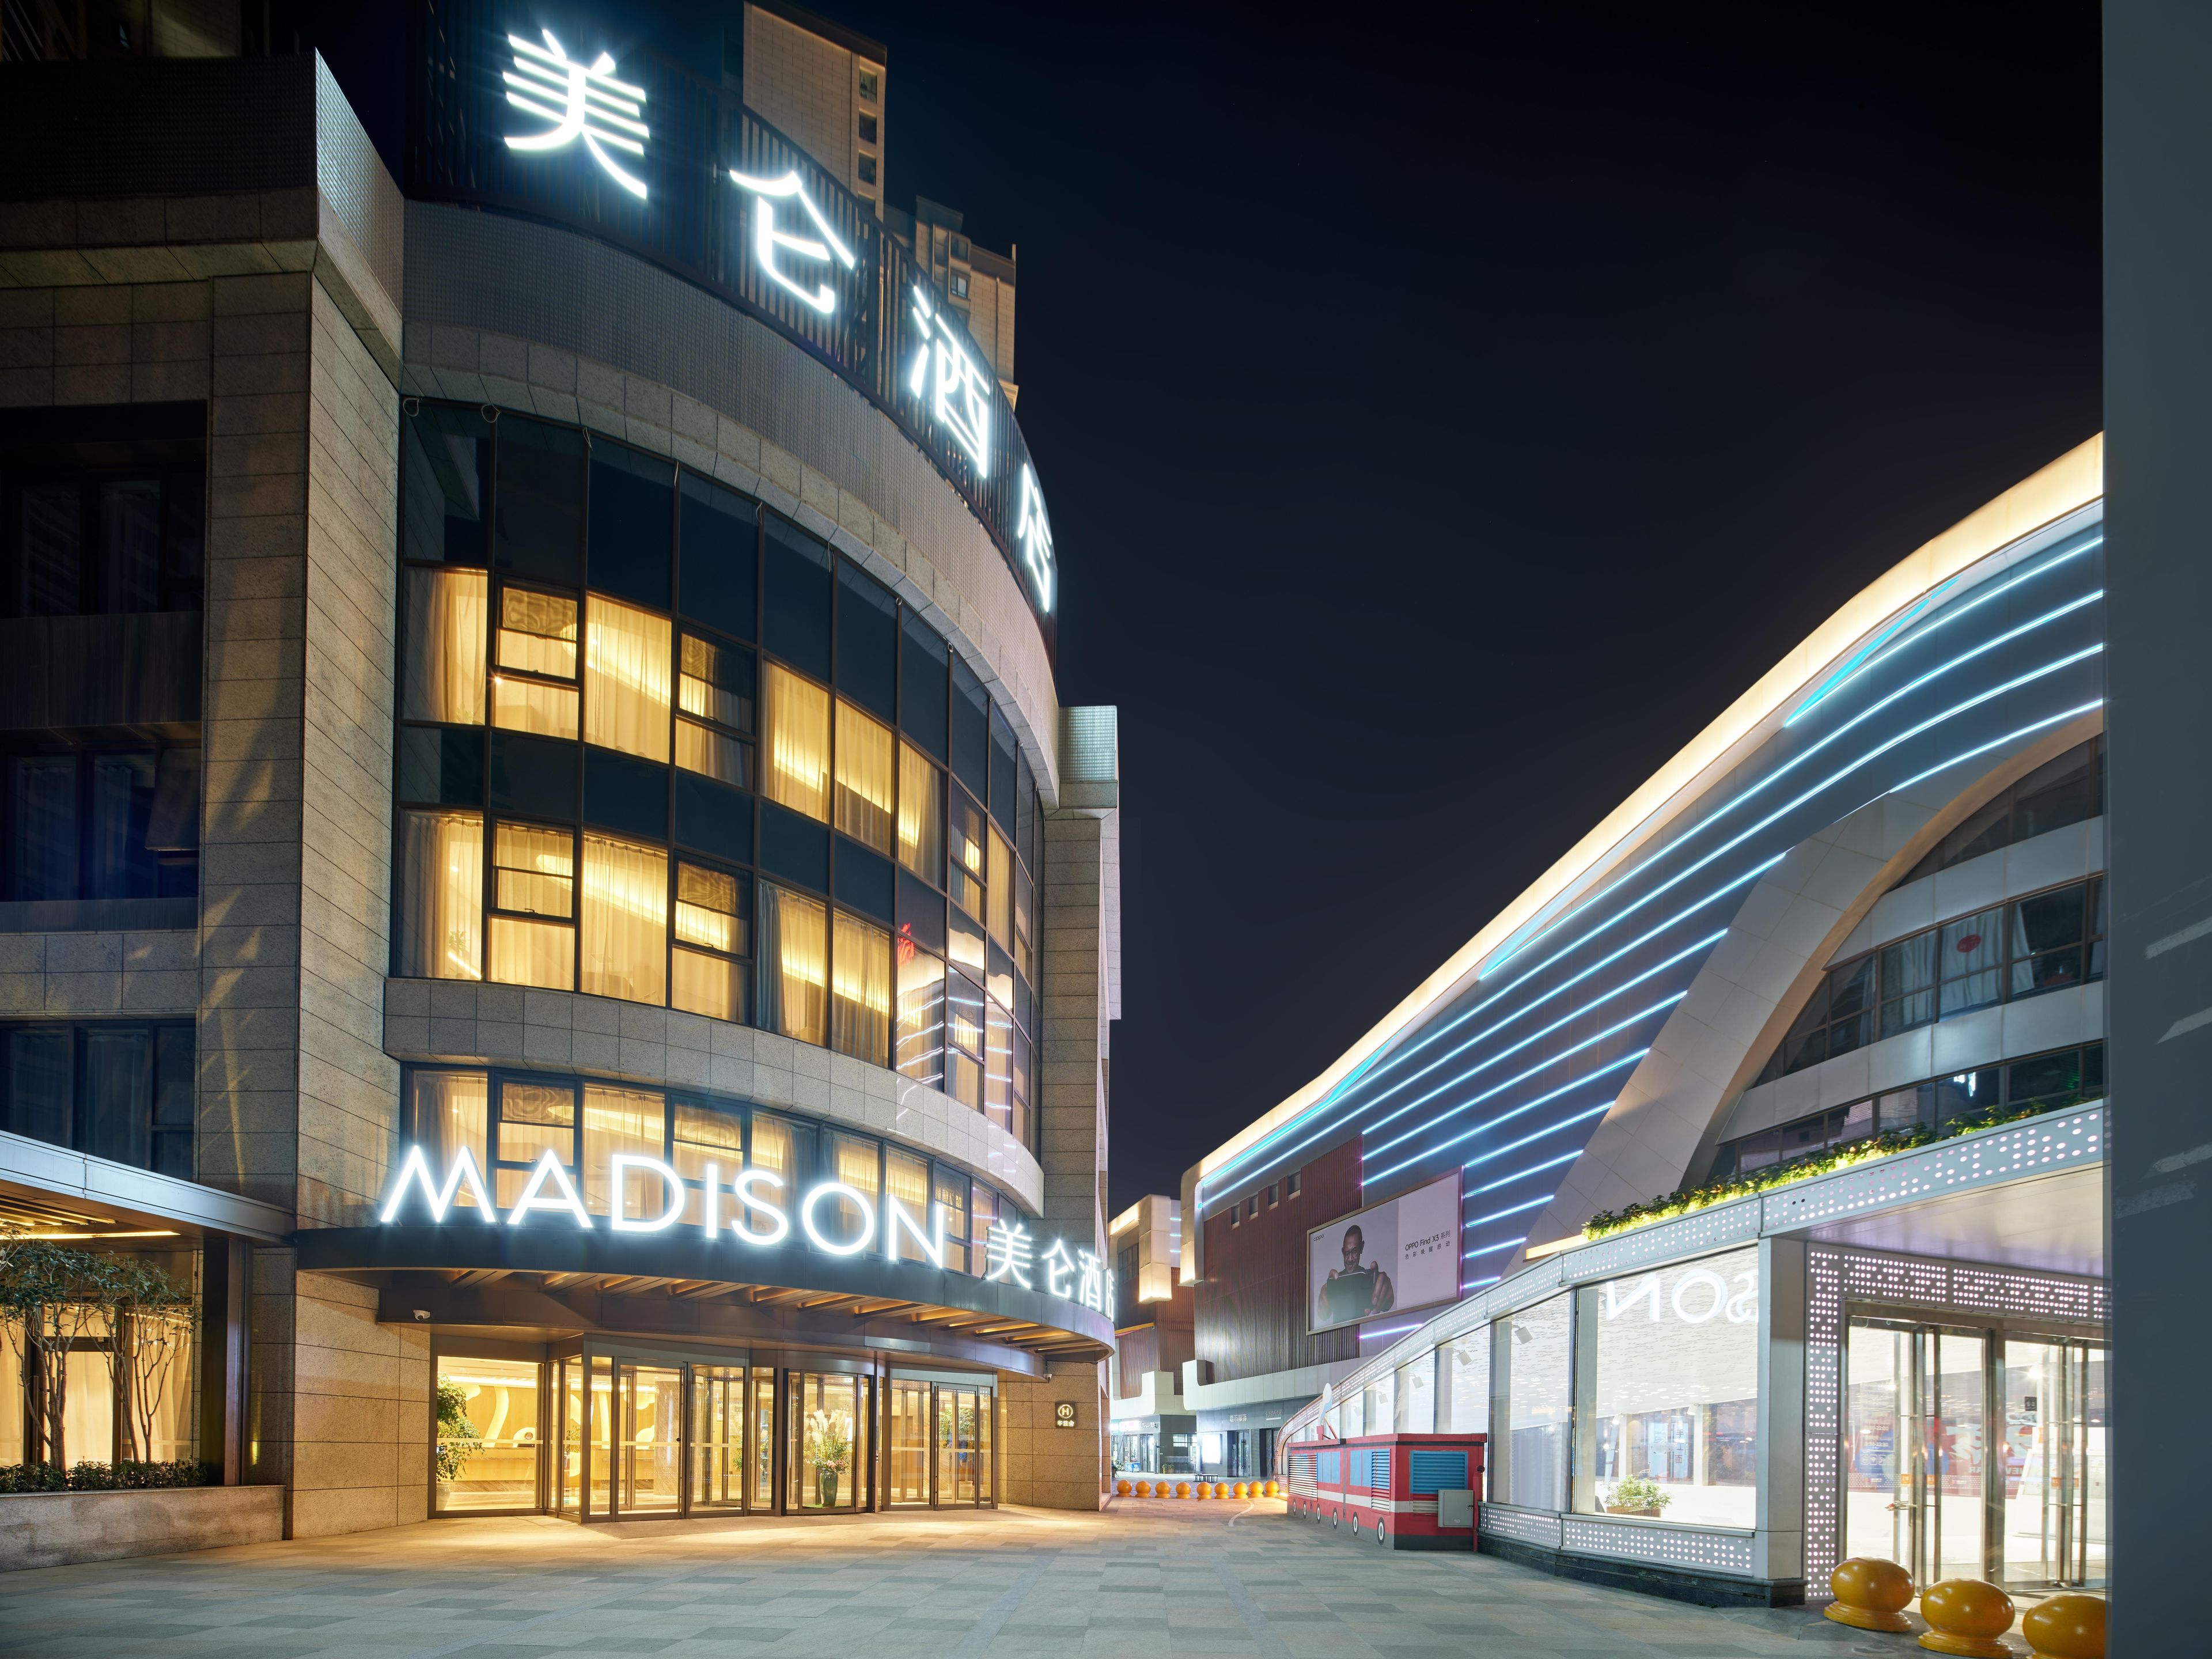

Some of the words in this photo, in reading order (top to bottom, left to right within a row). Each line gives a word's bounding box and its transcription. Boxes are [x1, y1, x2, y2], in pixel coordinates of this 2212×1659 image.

[502, 28, 1052, 613] 美仑酒店
[380, 1145, 944, 1268] MADISON
[986, 1218, 1115, 1323] 美仑酒店
[1406, 1241, 1418, 1251] OPPO
[1420, 1237, 1430, 1246] Find
[1432, 1234, 1439, 1242] X3
[1441, 1230, 1450, 1239] 系列
